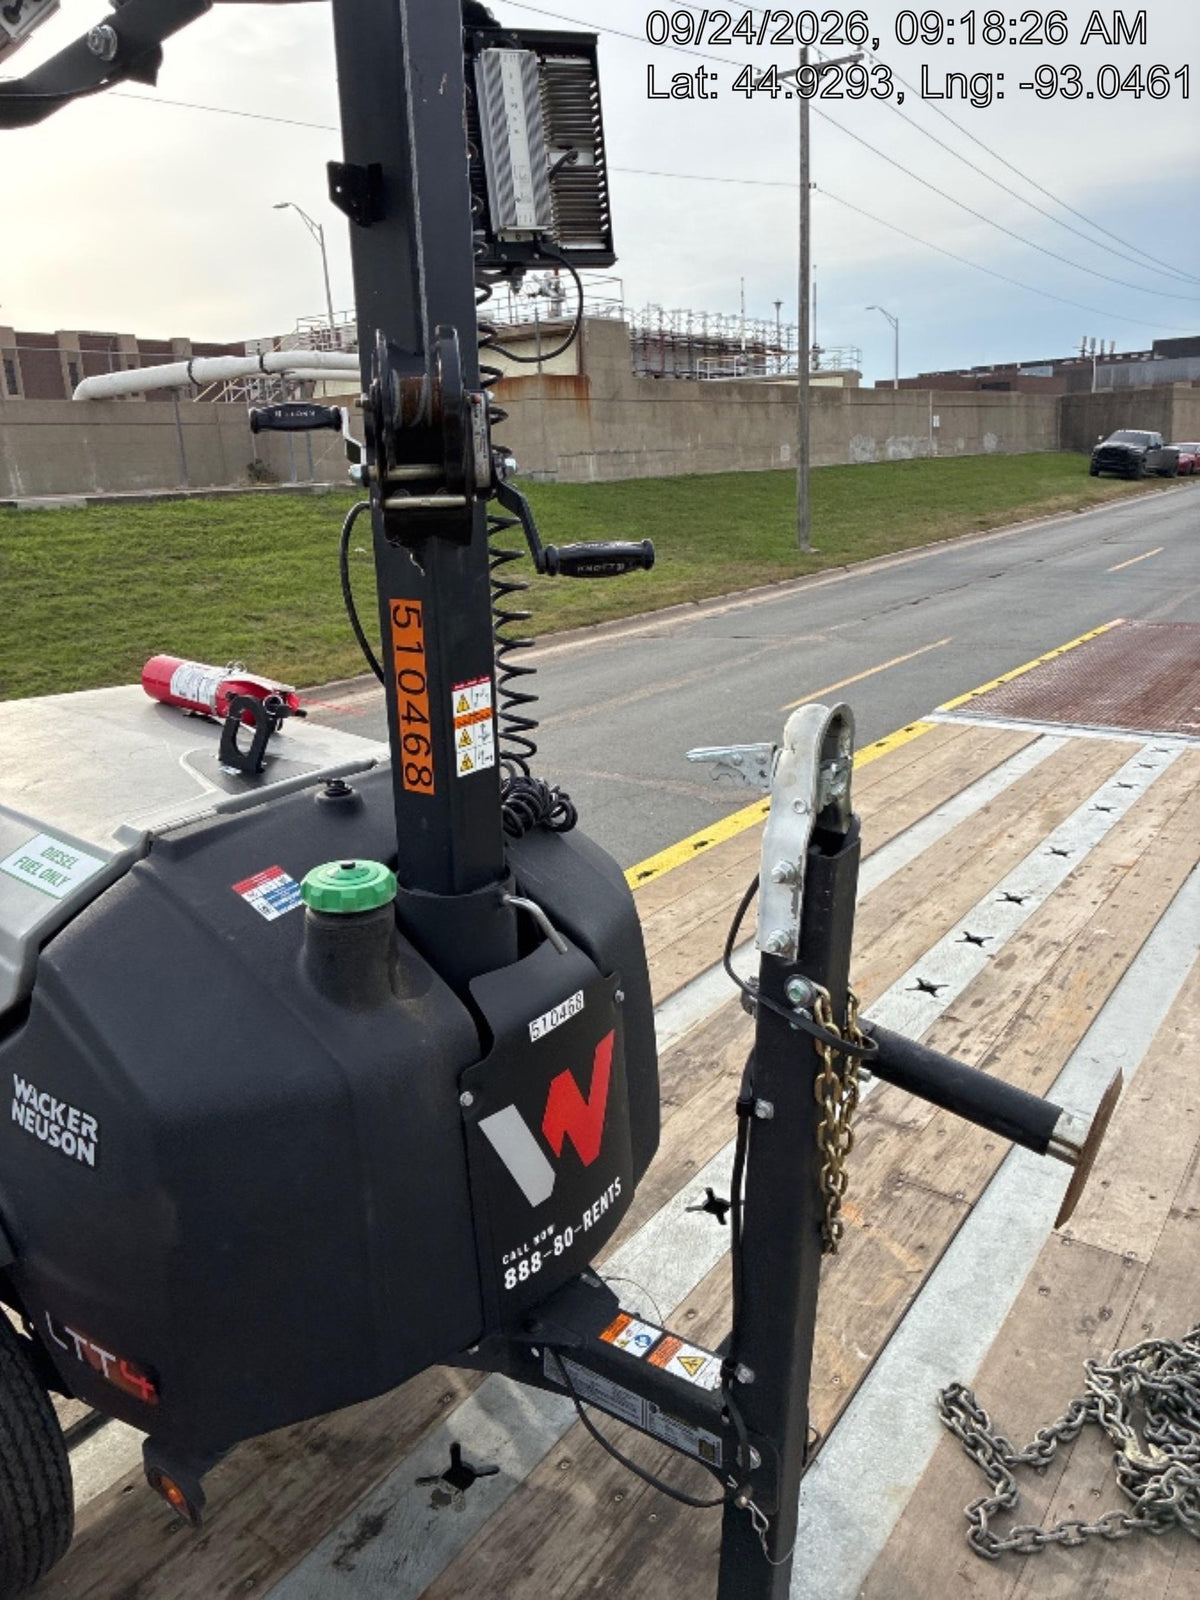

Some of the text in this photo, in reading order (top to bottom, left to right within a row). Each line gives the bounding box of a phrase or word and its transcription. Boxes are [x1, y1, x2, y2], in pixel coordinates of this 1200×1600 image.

[392, 604, 433, 787] 510468
[13, 856, 72, 888] FUEL ONLY
[41, 846, 80, 870] DIESEL
[530, 993, 583, 1039] 510468
[11, 1098, 96, 1167] NEUSON
[12, 1073, 99, 1143] WACKER
[502, 1223, 556, 1265] CALL NOW
[504, 1176, 622, 1290] 888-80-RENTS
[45, 1310, 156, 1400] LTT4
